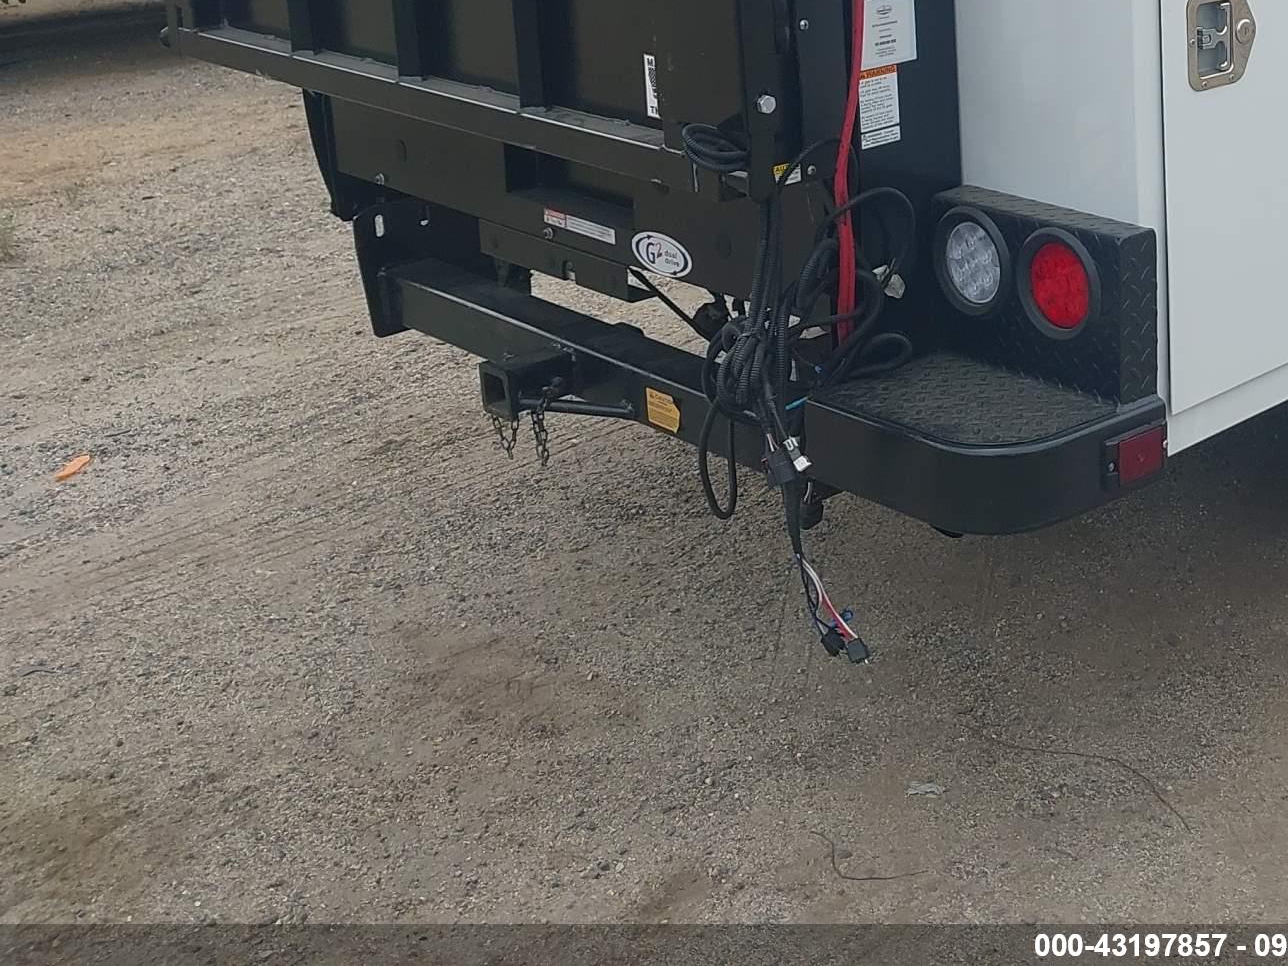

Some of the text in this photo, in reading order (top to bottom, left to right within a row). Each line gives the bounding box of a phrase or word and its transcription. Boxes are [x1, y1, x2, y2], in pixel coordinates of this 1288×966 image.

[865, 65, 896, 78] WARNING
[664, 250, 679, 260] dual
[665, 257, 681, 268] drive
